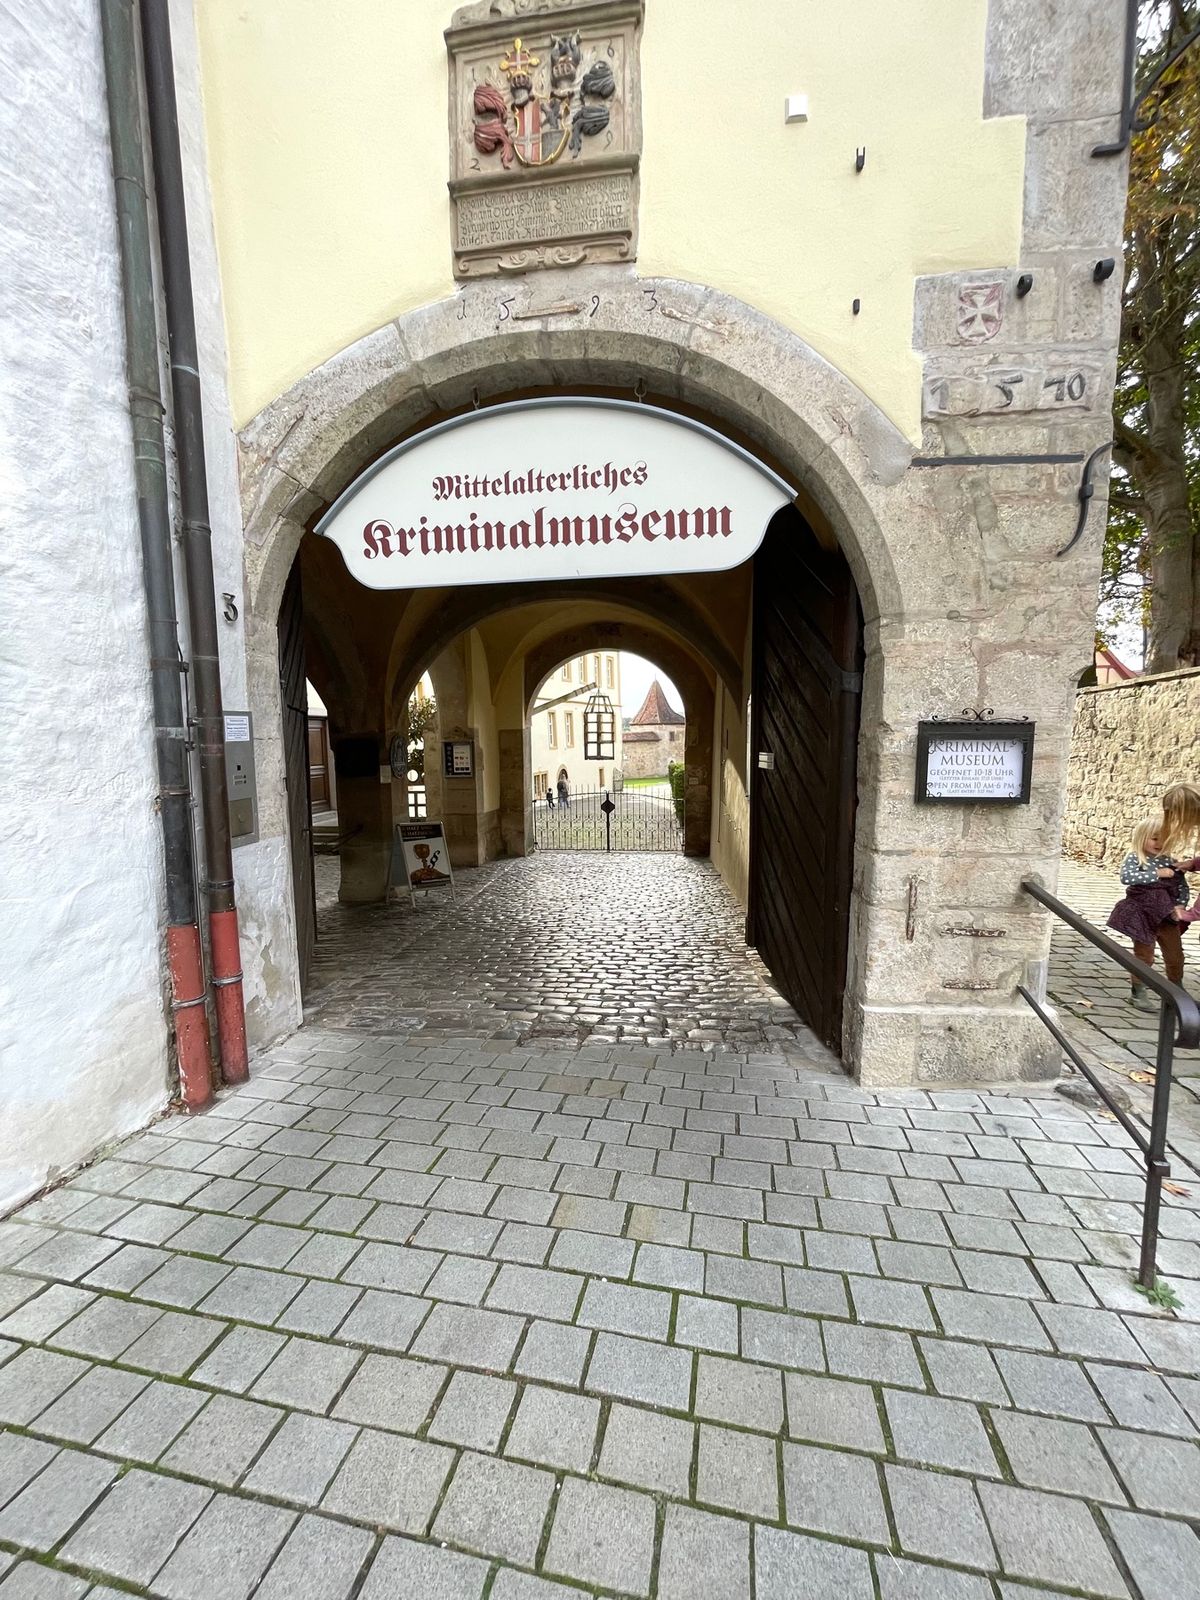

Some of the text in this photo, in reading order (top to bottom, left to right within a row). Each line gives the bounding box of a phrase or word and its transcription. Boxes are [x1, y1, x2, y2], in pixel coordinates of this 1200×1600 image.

[432, 460, 648, 503] Mittelalterliches
[363, 502, 733, 561] Kriminalmuseum
[222, 592, 239, 622] 3
[940, 754, 1004, 766] MUSEUM
